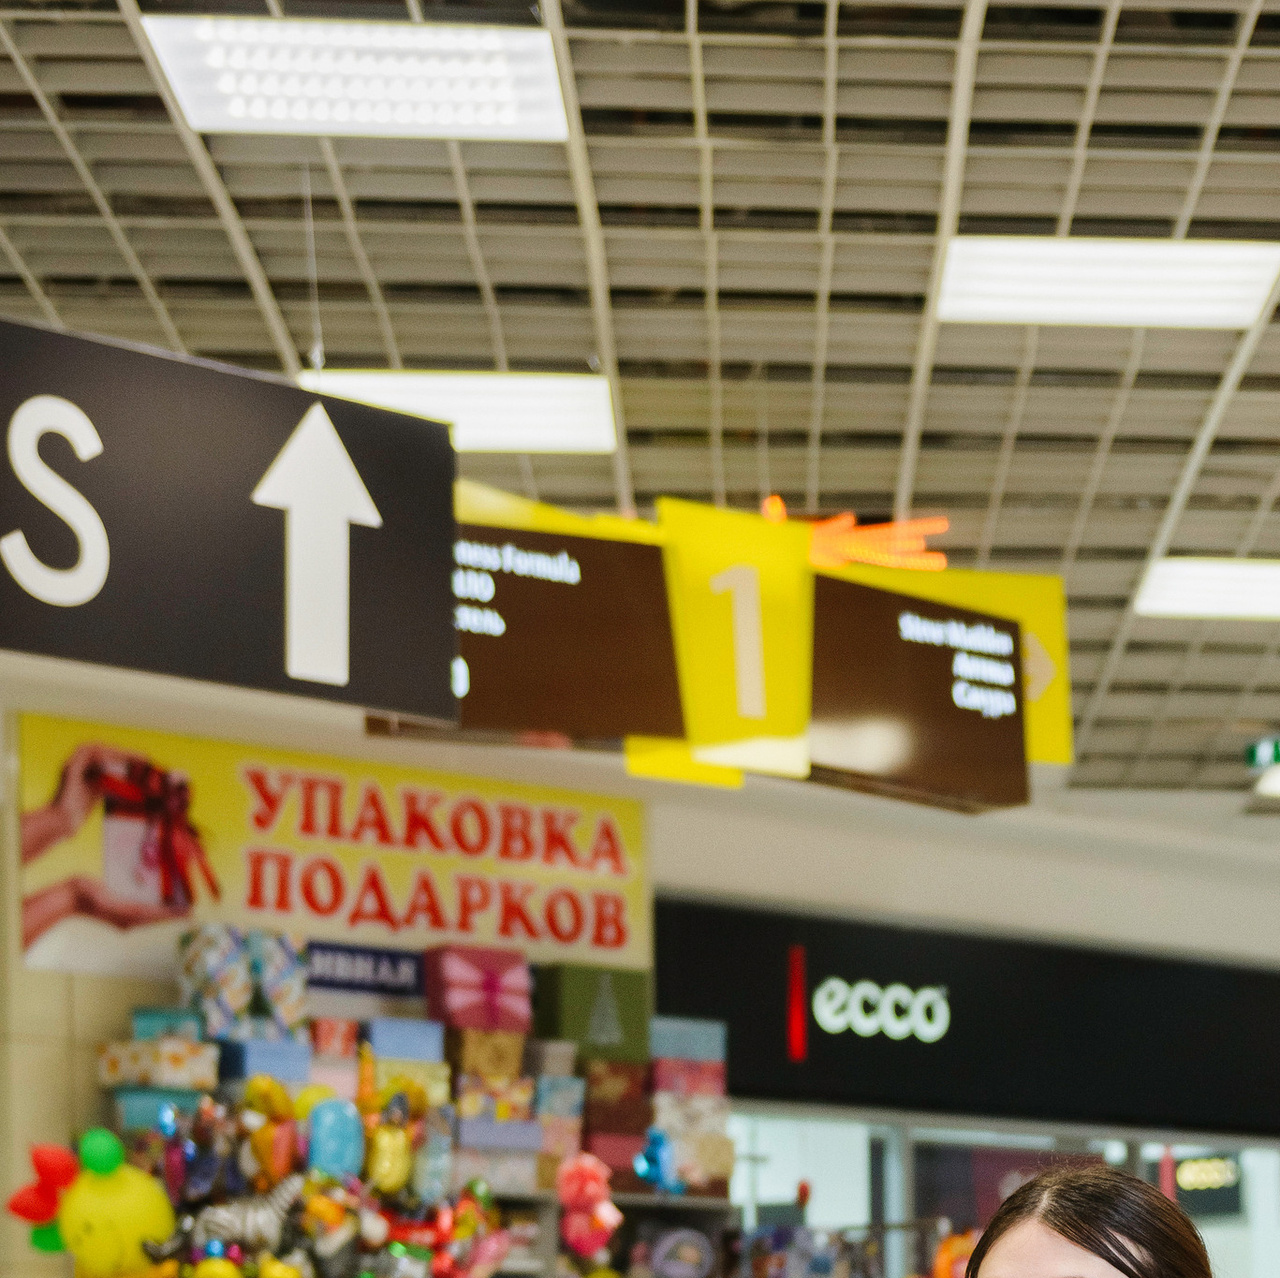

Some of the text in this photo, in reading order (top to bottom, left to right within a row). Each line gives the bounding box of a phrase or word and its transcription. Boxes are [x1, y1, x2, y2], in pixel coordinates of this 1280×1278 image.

[0, 394, 111, 607] S
[710, 565, 766, 719] 1
[243, 769, 628, 876] УПАКОВКА
[247, 850, 629, 952] ПОДАРКОВ
[812, 976, 950, 1044] ecco
